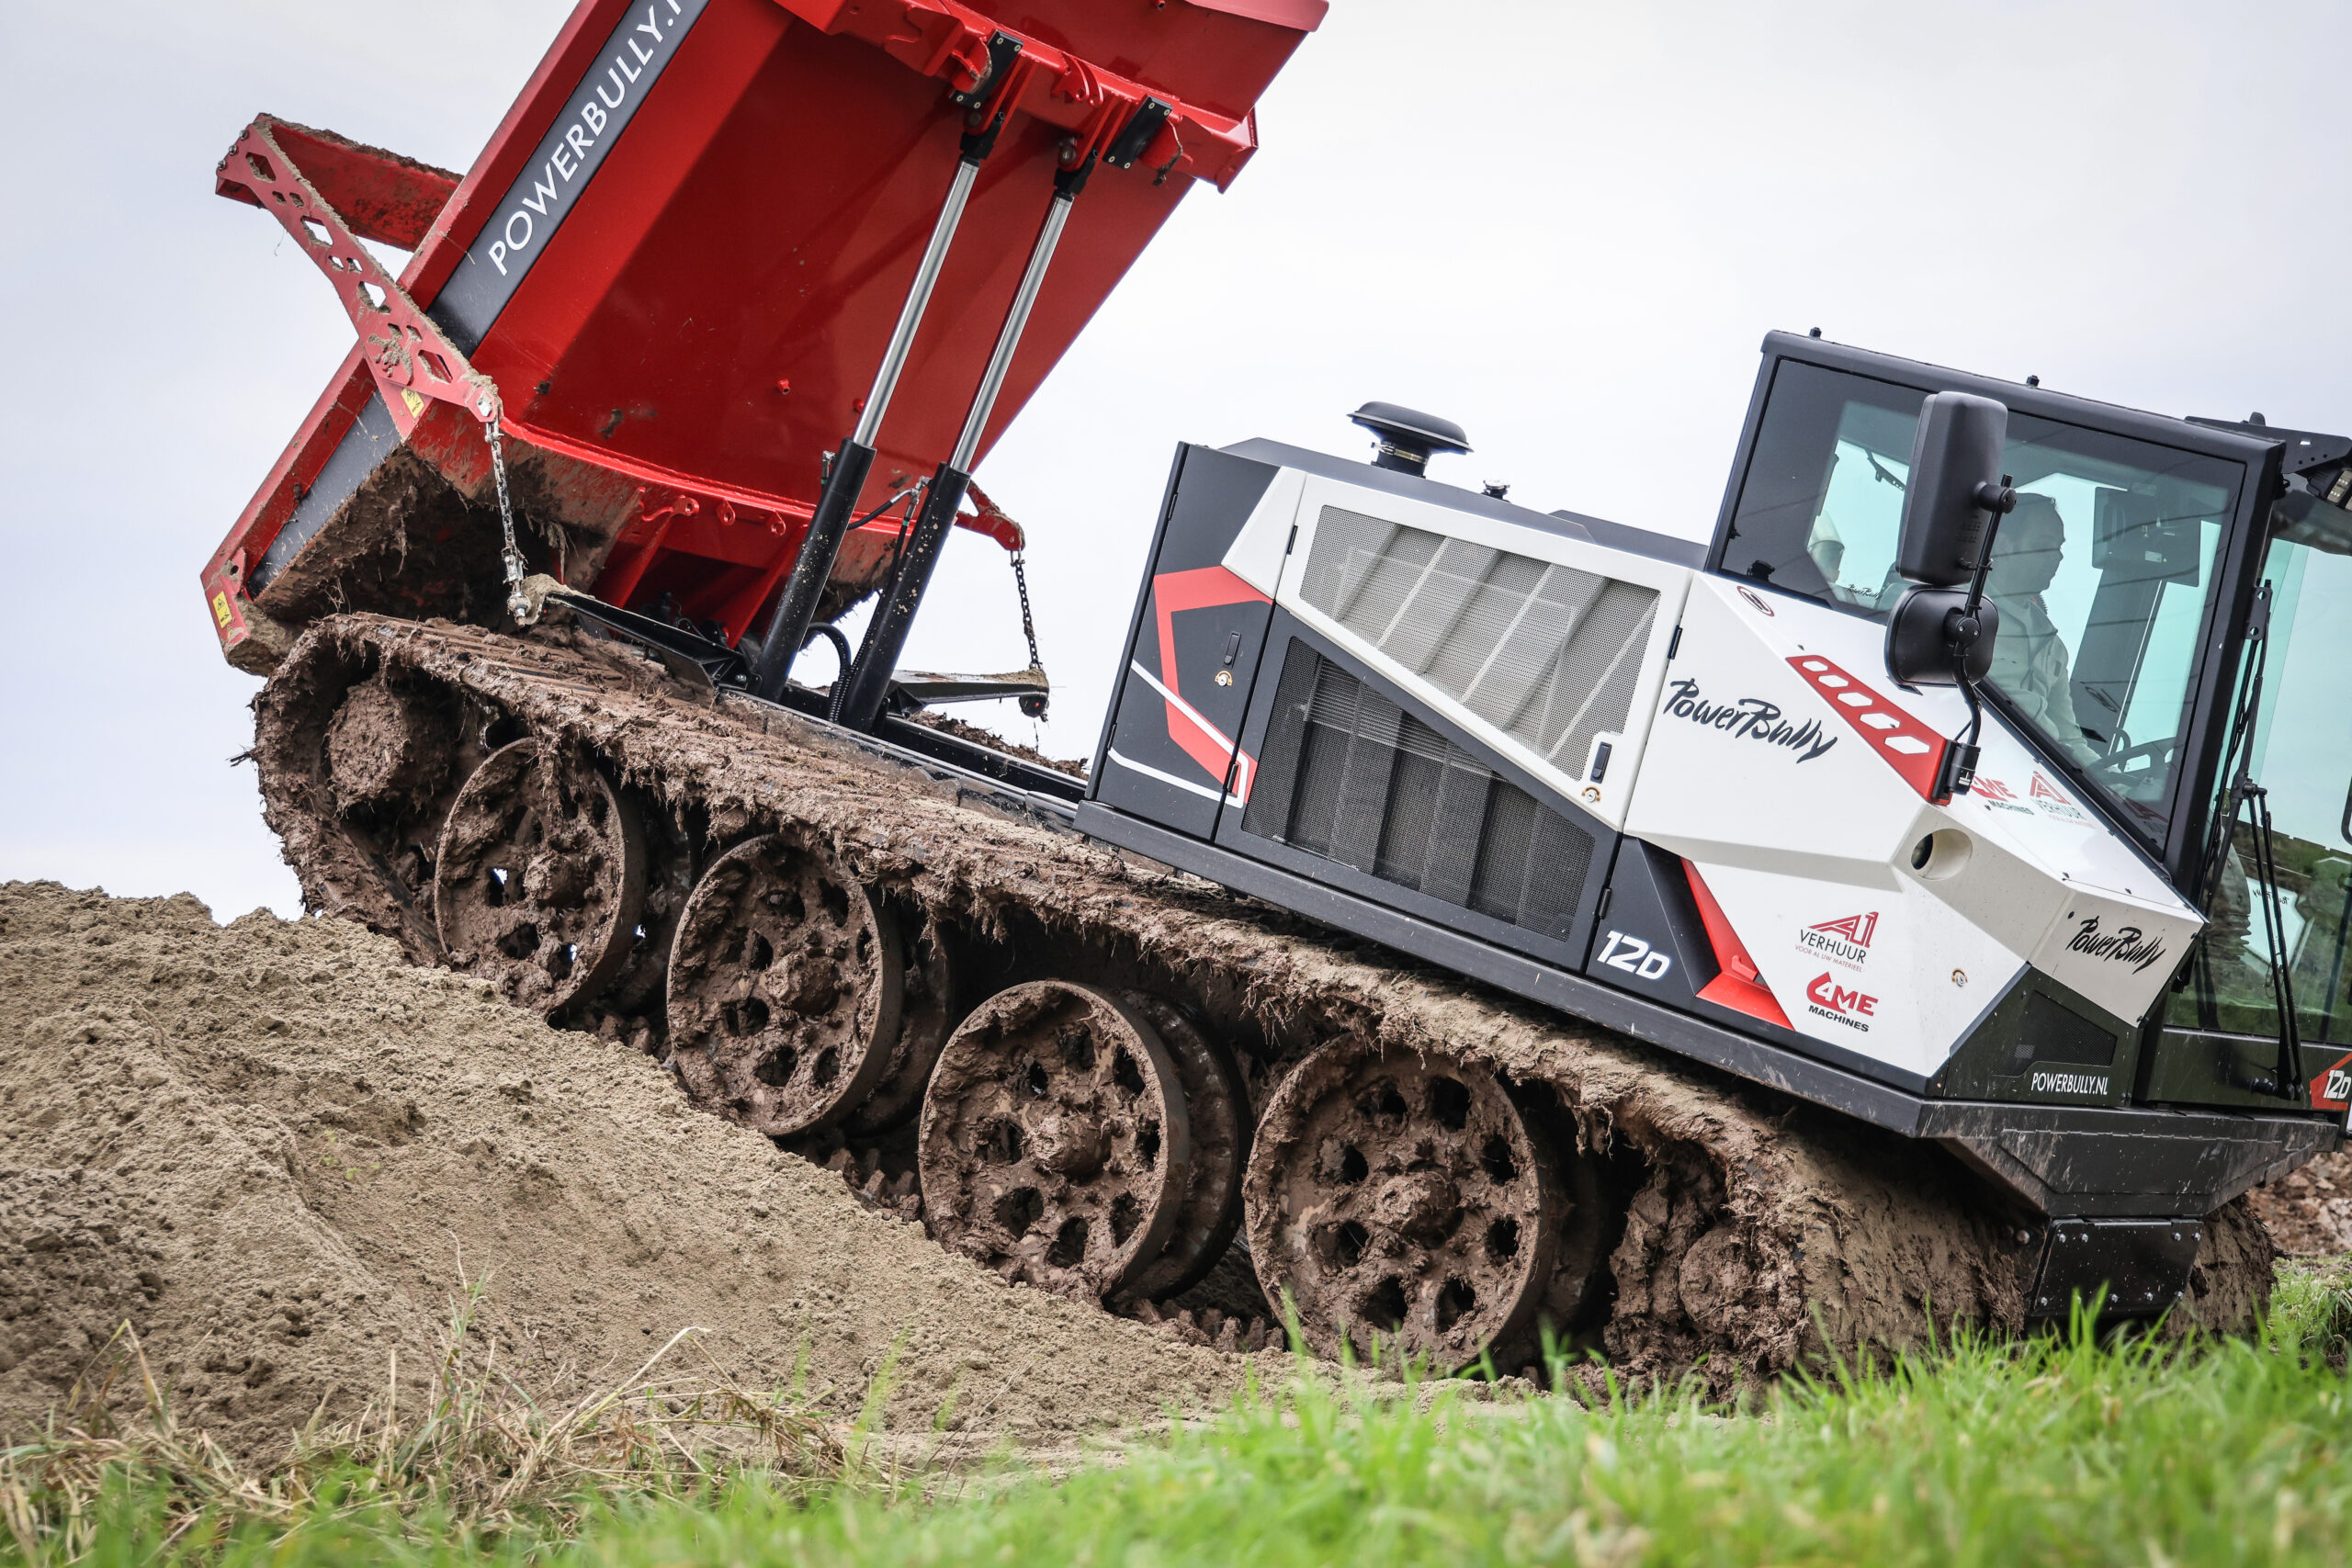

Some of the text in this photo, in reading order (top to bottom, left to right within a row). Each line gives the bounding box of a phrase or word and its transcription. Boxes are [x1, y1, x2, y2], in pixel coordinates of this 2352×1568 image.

[1664, 678, 1838, 764] PowerBully
[1795, 944, 1813, 955] VOOR
[1821, 953, 1832, 962] UW
[1833, 958, 1862, 973] MATERIEEL
[1800, 929, 1867, 964] VERHUUR
[2065, 915, 2166, 975] PowerBully
[1808, 1005, 1870, 1032] MACHINES
[2030, 1072, 2109, 1095] POWERBULLY.NL
